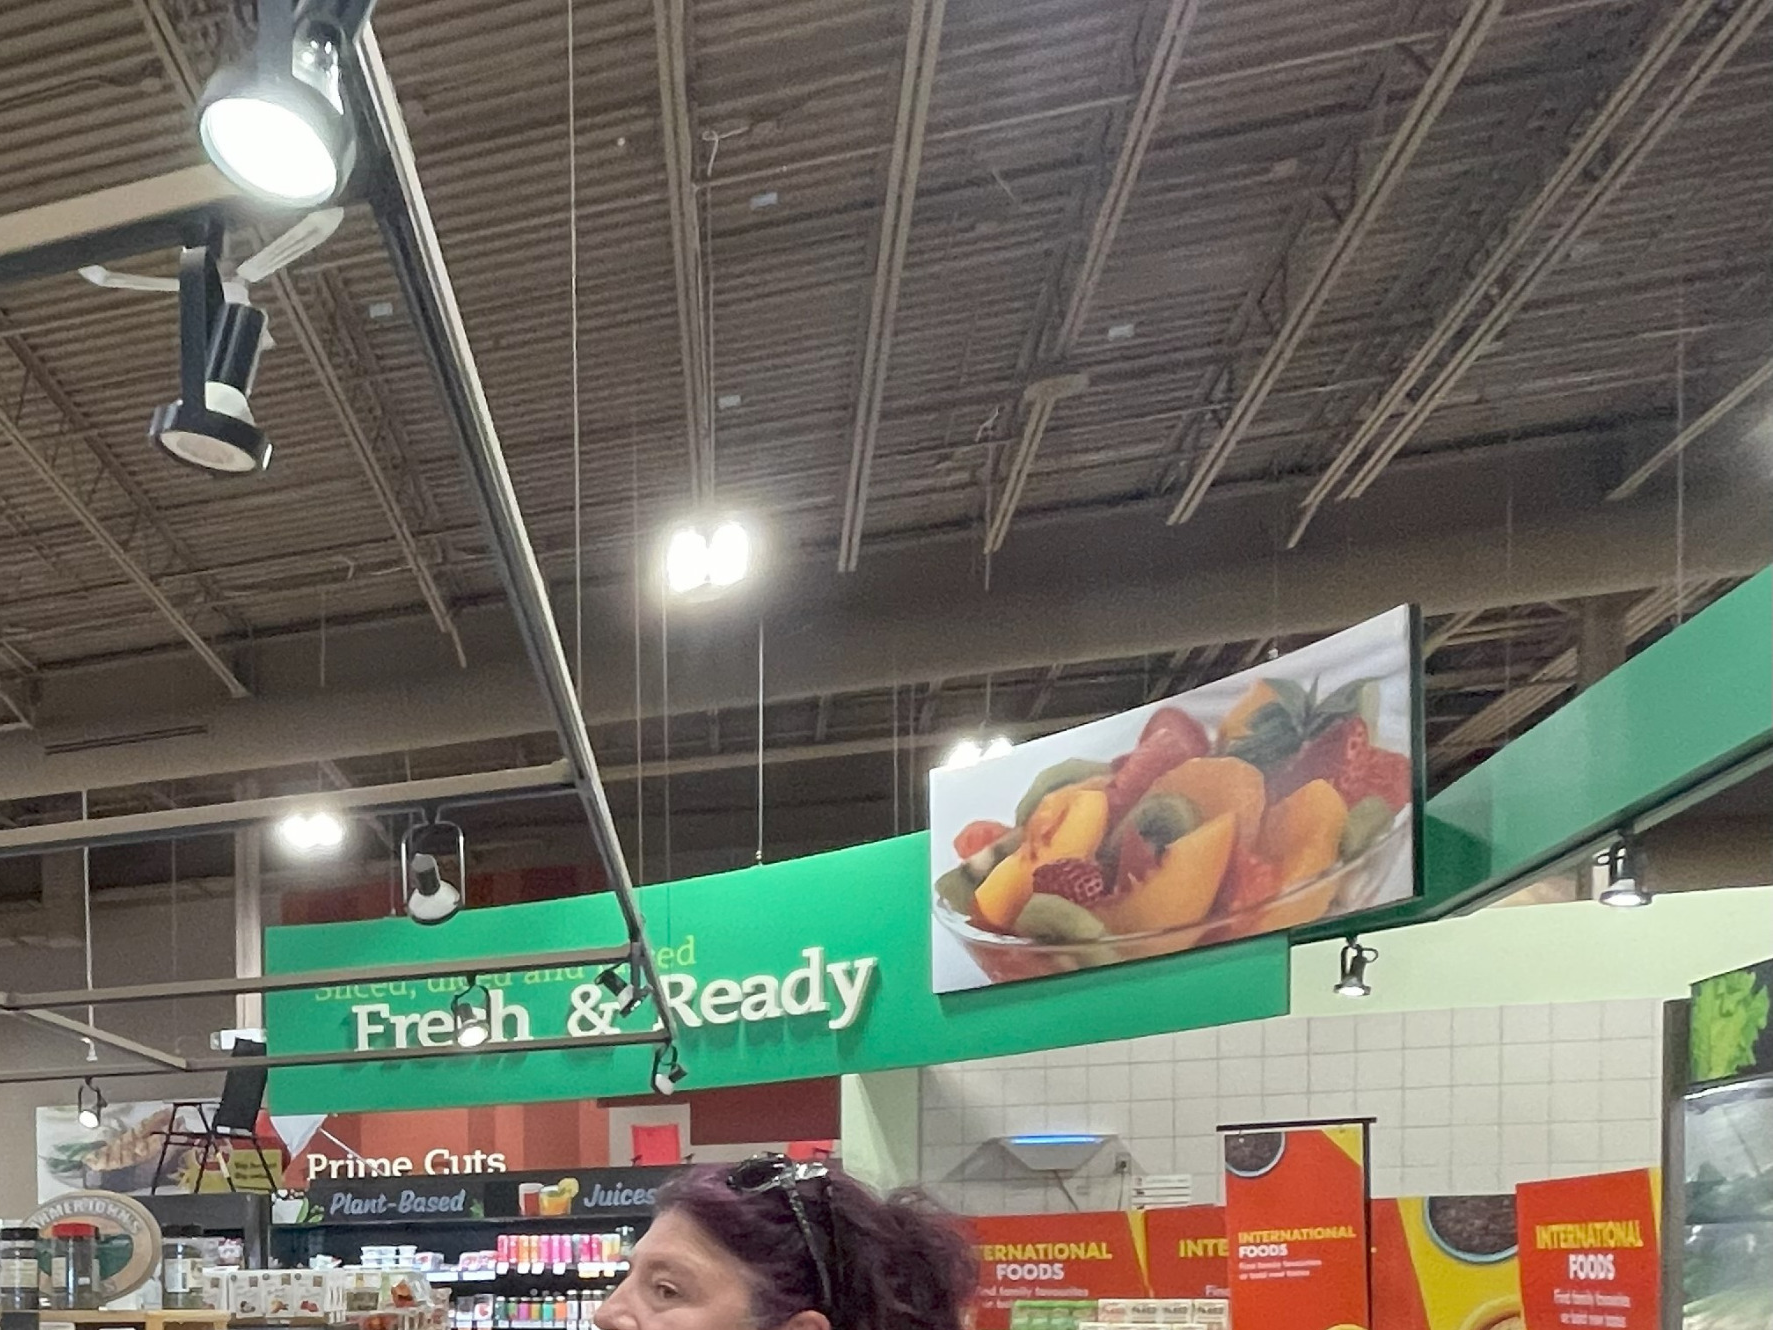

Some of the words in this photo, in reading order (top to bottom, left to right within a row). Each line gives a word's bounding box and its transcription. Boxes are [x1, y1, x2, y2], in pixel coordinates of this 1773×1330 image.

[352, 989, 534, 1052] Freh
[566, 983, 621, 1038] &
[653, 946, 877, 1030] Ready
[306, 1153, 413, 1180] Prime
[424, 1148, 507, 1176] Cuts
[329, 1188, 467, 1216] Plant-Based
[583, 1181, 659, 1208] Juices
[1238, 1225, 1357, 1244] INTERNATIONAL
[1535, 1220, 1644, 1250] INTERNATIONAL
[983, 1242, 1113, 1261] ERNATIONAL
[1238, 1243, 1289, 1259] FOODS
[995, 1263, 1065, 1281] FOODS
[1568, 1253, 1616, 1280] FOODS
